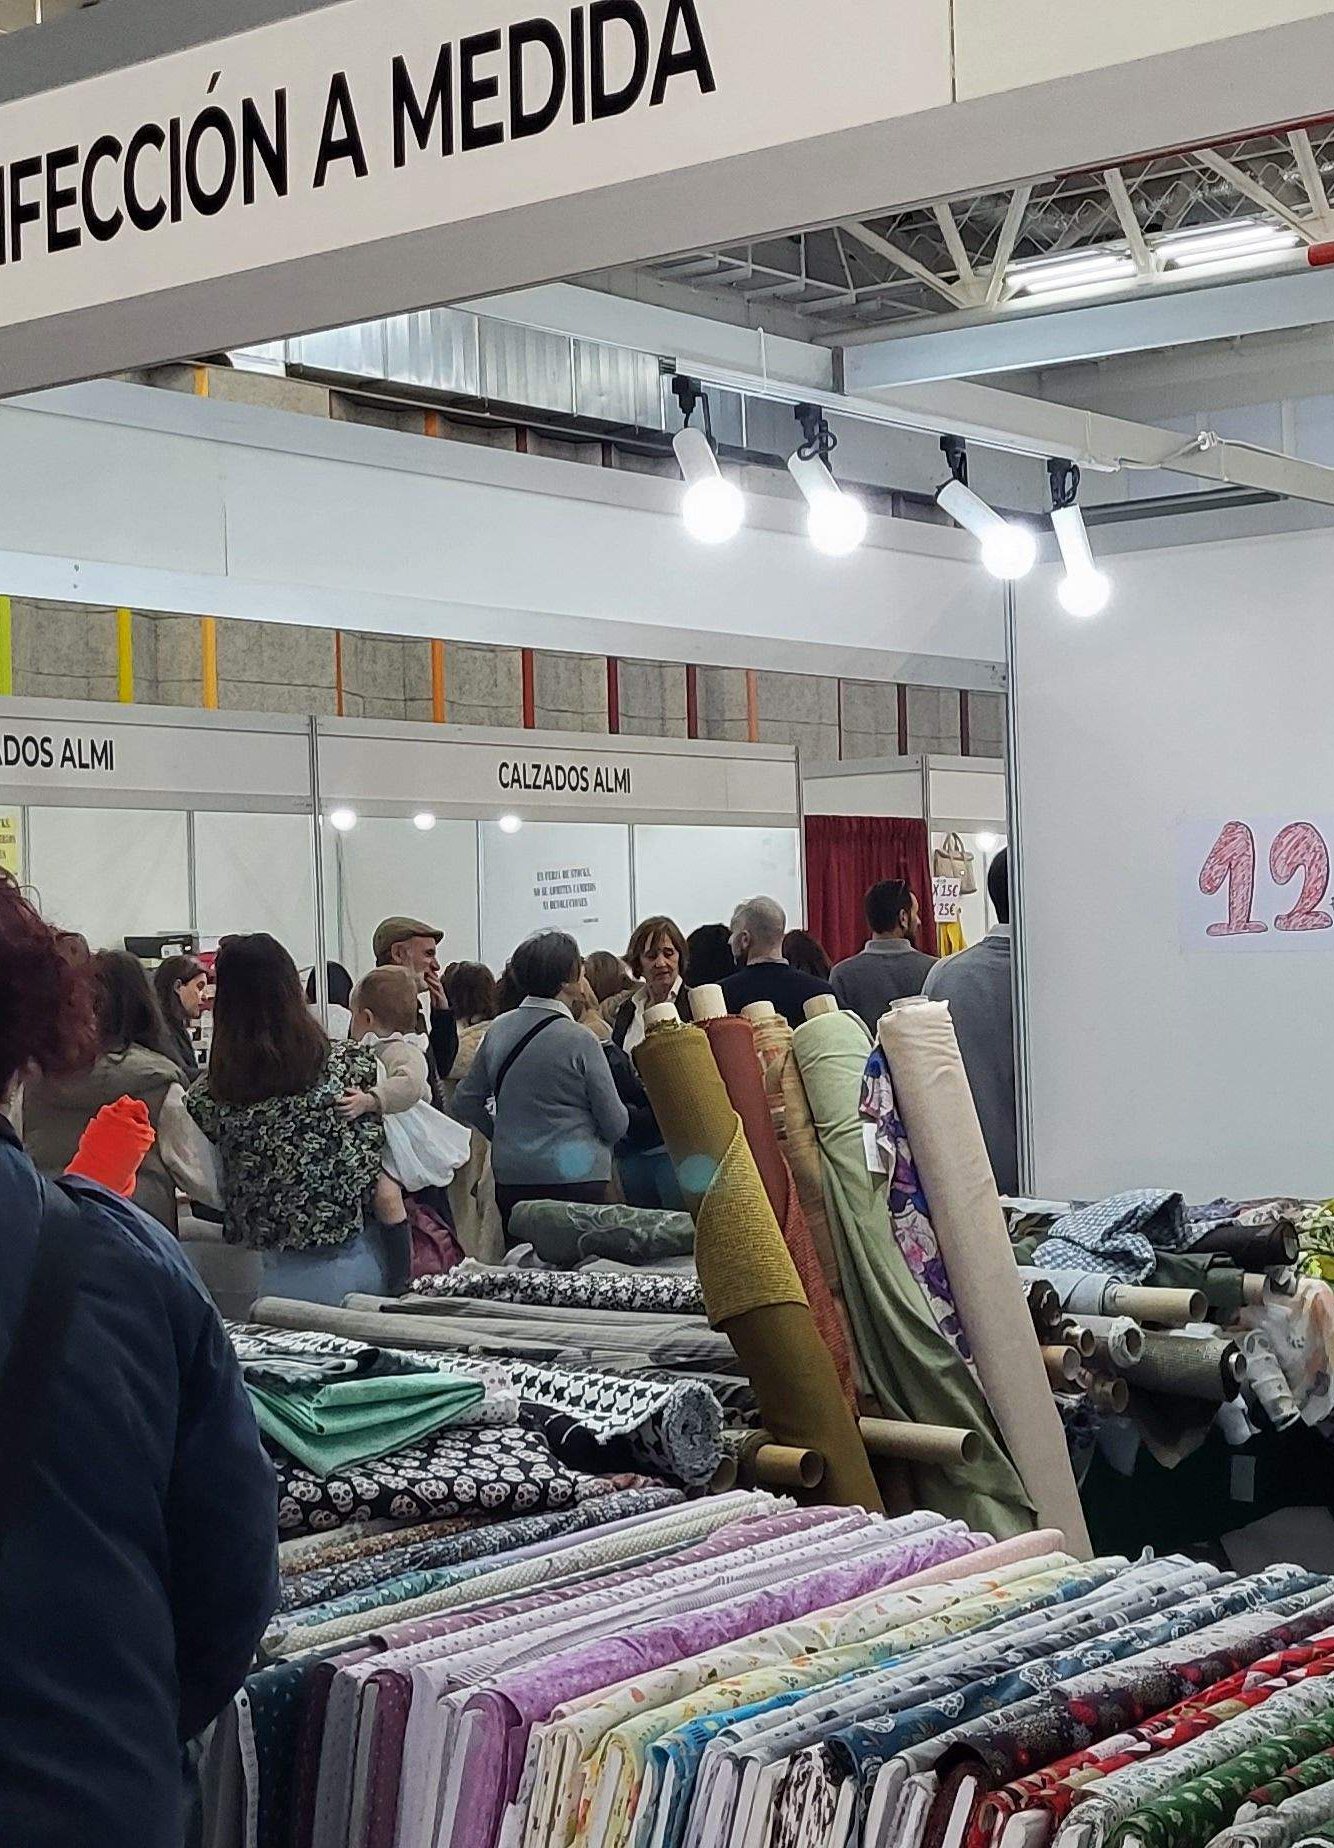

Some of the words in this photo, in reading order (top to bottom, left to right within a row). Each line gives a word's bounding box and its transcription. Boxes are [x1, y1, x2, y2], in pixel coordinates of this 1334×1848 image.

[312, 71, 369, 188] A
[392, 0, 717, 169] MEDIDA
[59, 737, 114, 771] ALMI
[498, 761, 590, 792] CALZADOS
[593, 766, 631, 794] ALMI
